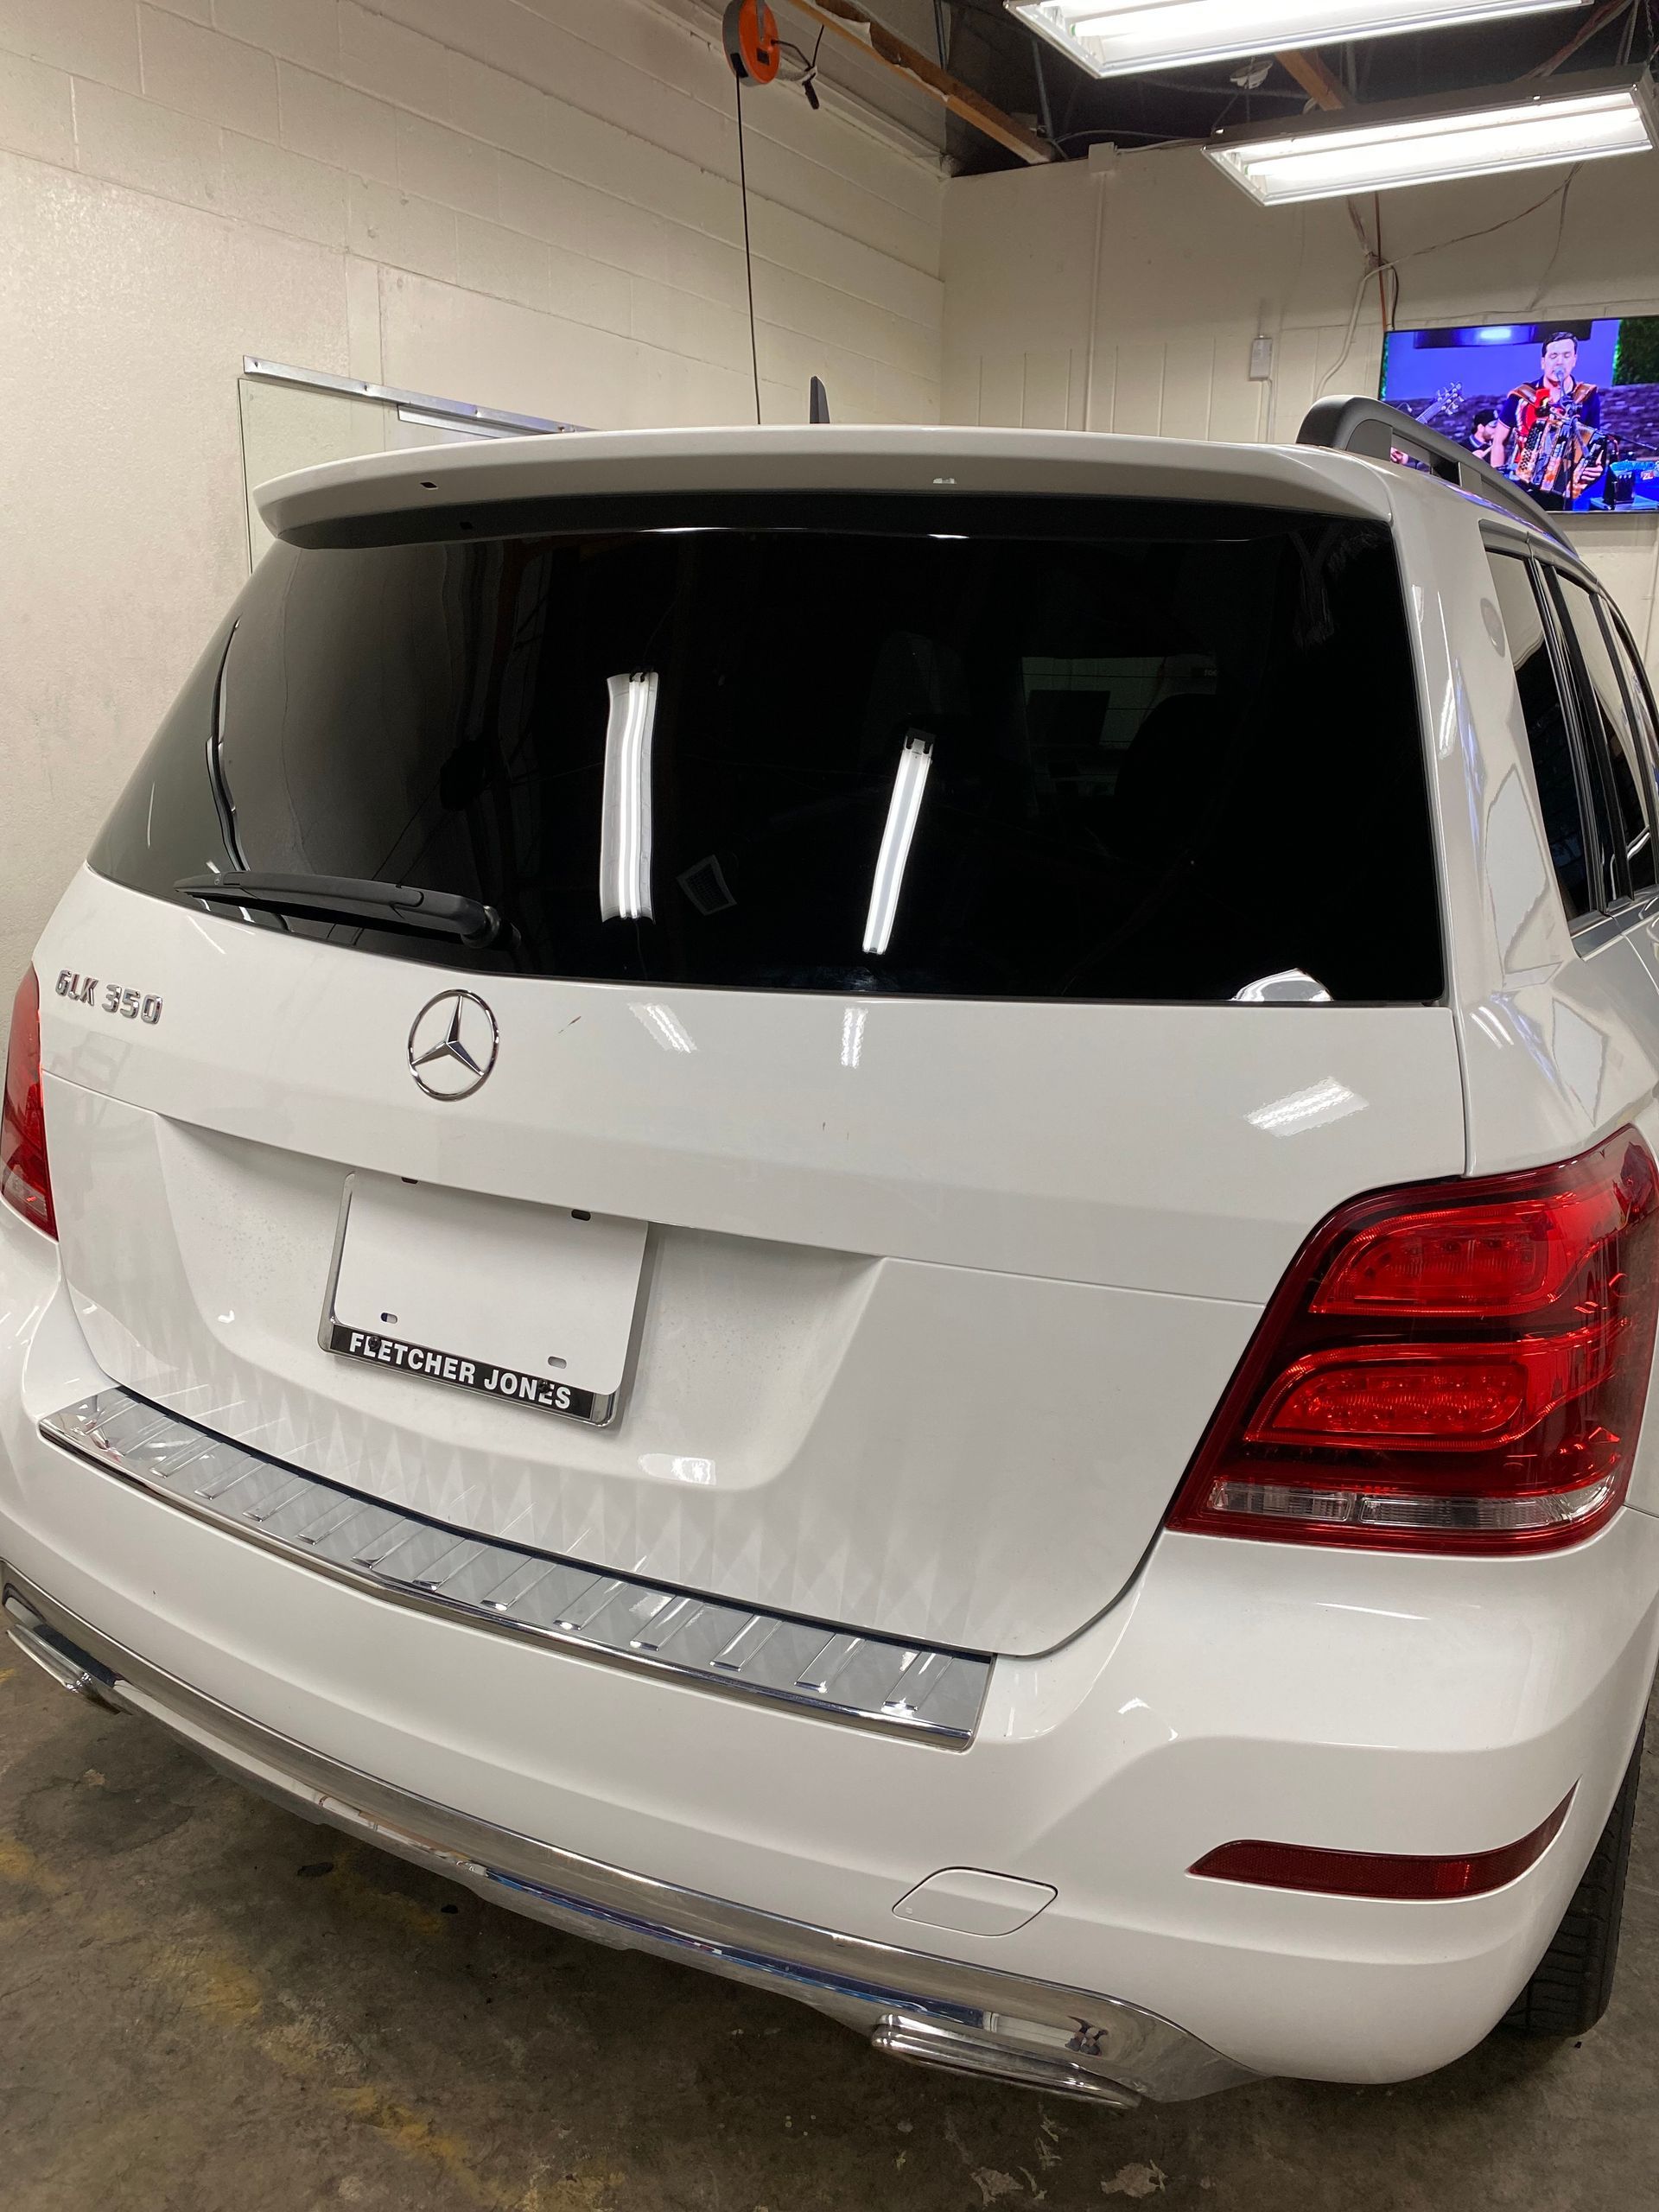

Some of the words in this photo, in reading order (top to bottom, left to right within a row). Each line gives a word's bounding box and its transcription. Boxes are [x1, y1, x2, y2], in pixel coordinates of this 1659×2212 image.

[54, 969, 99, 1007] GLK
[101, 984, 163, 1025] 350
[349, 1332, 476, 1384] FLETCHER
[484, 1370, 571, 1409] JONES
